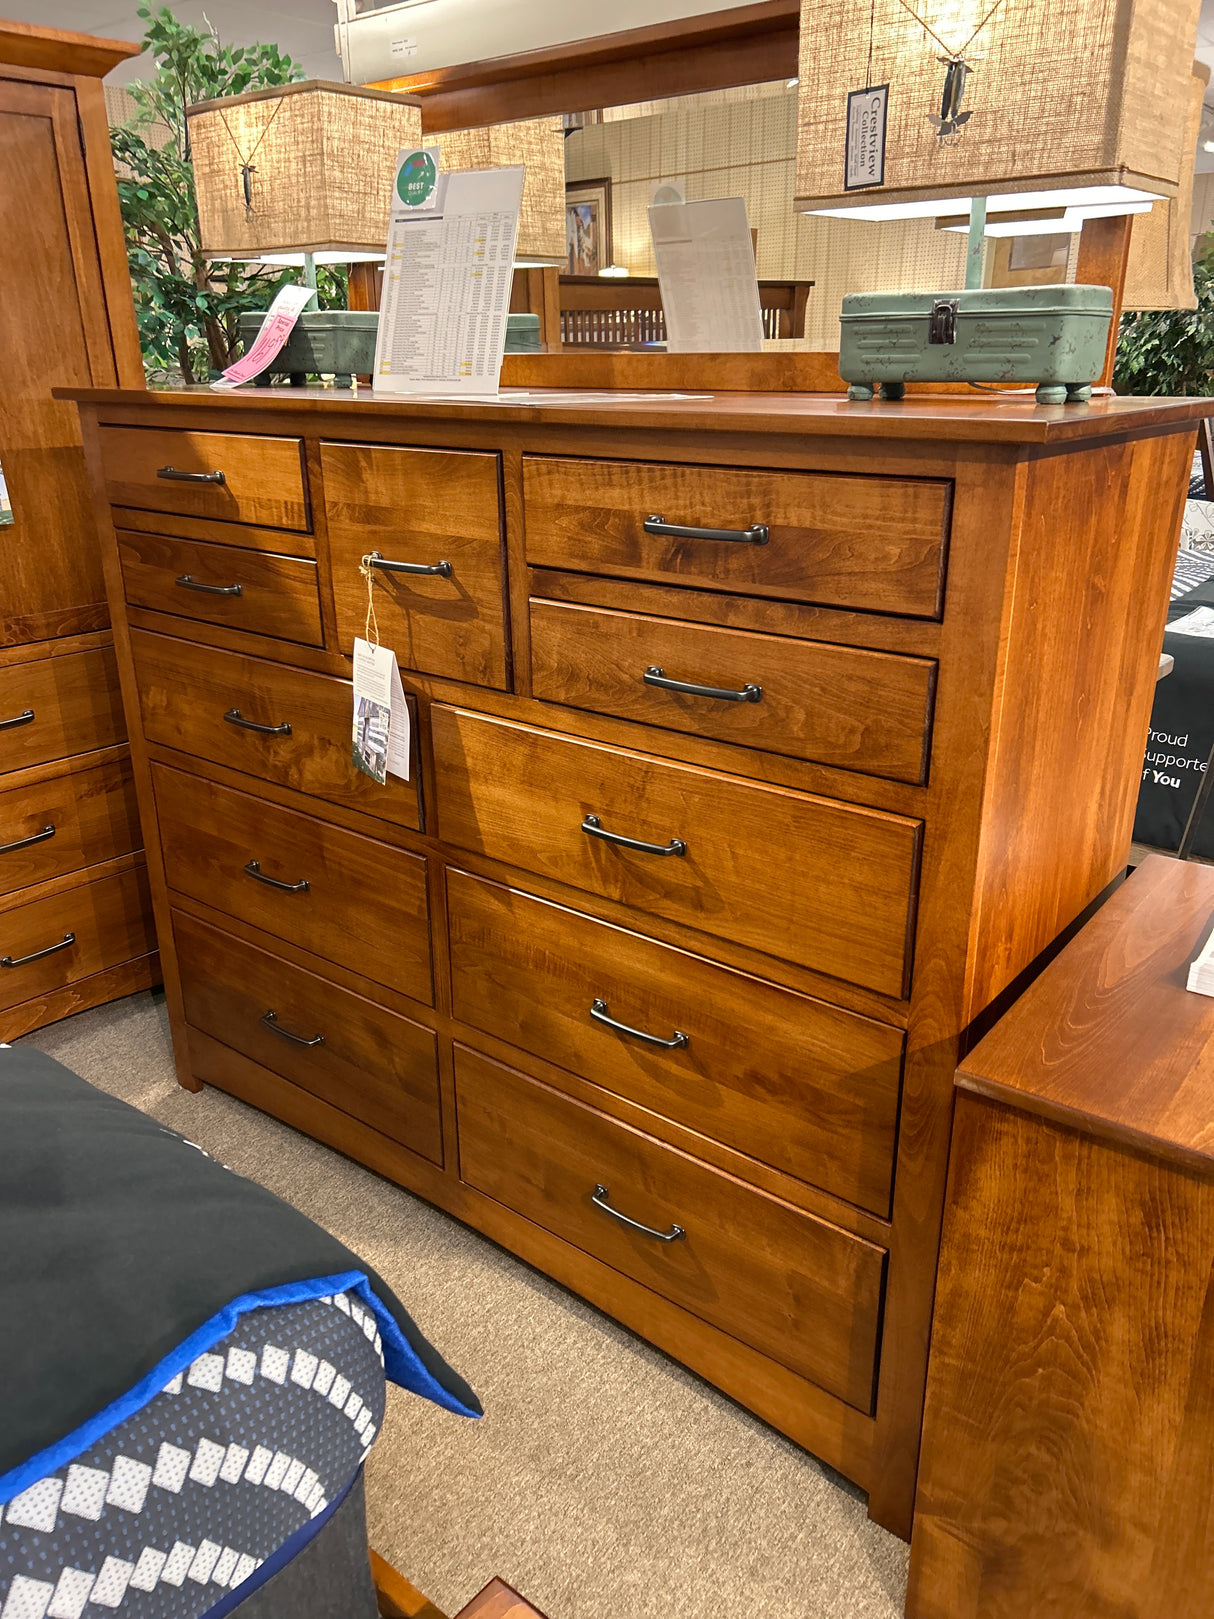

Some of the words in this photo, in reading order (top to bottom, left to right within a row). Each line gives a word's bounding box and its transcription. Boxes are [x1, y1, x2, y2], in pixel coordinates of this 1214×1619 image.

[859, 110, 870, 167] Collection
[867, 96, 882, 177] Crestview
[408, 182, 425, 191] BEST
[1144, 748, 1208, 773] upporte
[1142, 768, 1151, 781] f
[1152, 770, 1181, 789] You
